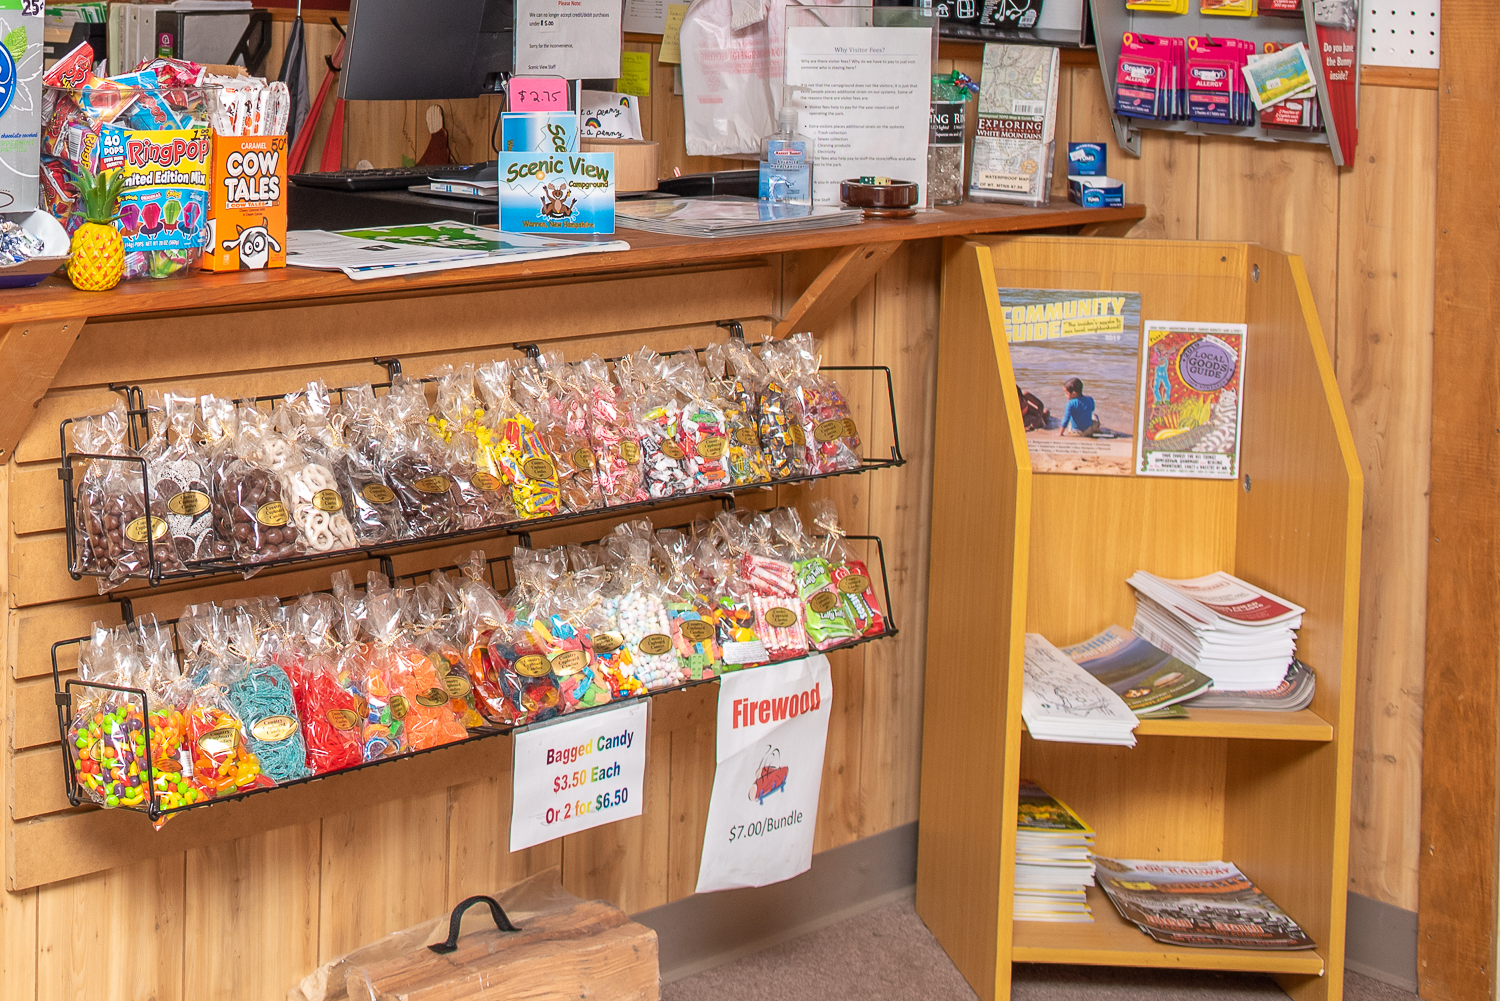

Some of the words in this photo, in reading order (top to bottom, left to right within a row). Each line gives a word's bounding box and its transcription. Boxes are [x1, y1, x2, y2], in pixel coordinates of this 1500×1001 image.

[530, 90, 562, 102] 2.75
[978, 119, 1042, 130] EXPLORING
[104, 134, 119, 146] 40
[241, 142, 266, 150] CARAMEL
[104, 146, 124, 156] POPS
[226, 151, 279, 176] COW
[507, 156, 564, 183] Scenic
[568, 156, 610, 182] View
[154, 170, 190, 185] Edition
[190, 170, 206, 186] Mix
[568, 180, 608, 189] Campground
[224, 176, 280, 202] TALES
[522, 220, 548, 228] Warren,
[1002, 297, 1126, 324] COMMUNITY
[1195, 350, 1225, 364] LOCAL
[1188, 358, 1228, 372] GOODS
[1190, 366, 1222, 379] GUIDE
[732, 682, 820, 729] Firewood
[546, 738, 593, 765] Bagged
[597, 729, 634, 748] Candy
[553, 769, 586, 794] $3.50
[590, 762, 620, 782] Each
[546, 808, 560, 824] Or
[564, 803, 571, 819] 2
[575, 800, 592, 816] for
[595, 787, 628, 812] $6.50
[728, 809, 803, 843] $7.00/Bundle
